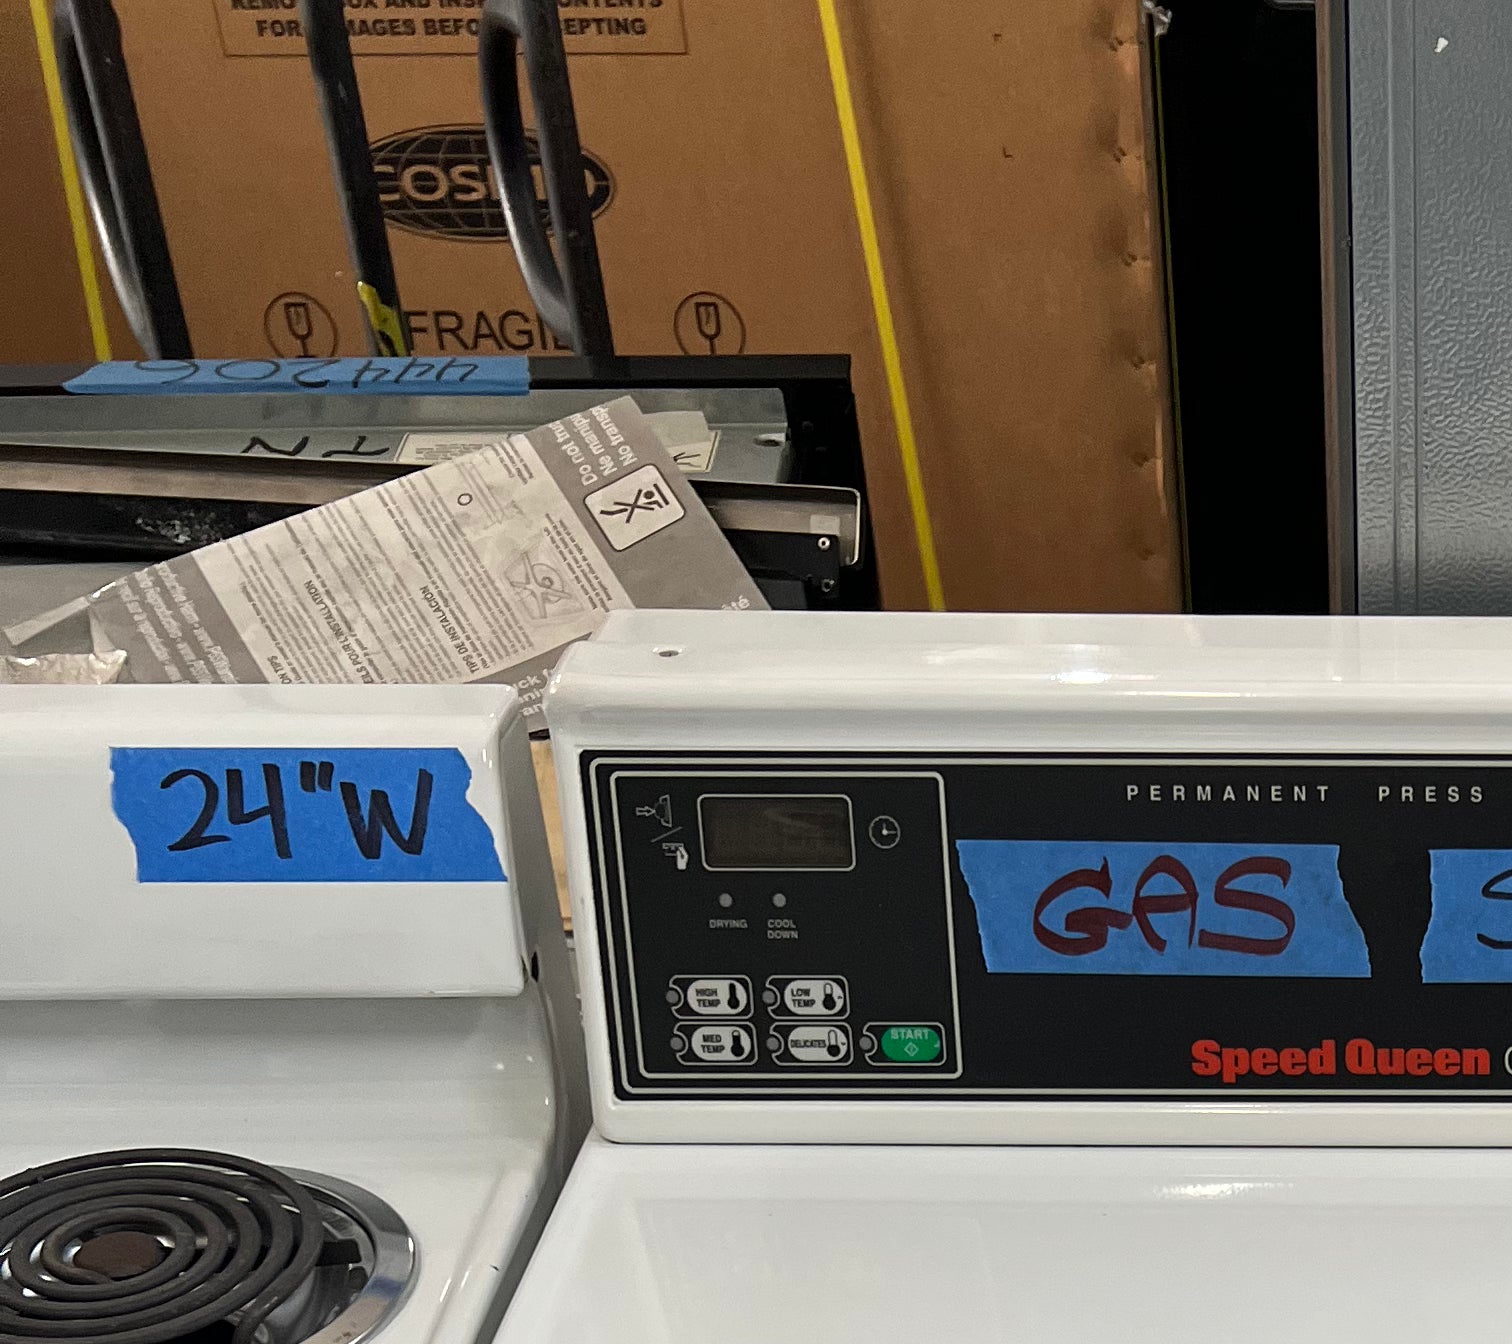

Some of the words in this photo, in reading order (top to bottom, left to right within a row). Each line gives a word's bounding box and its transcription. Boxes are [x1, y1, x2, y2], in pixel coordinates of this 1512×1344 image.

[423, 18, 480, 36] BEFO
[564, 17, 647, 36] EPTING
[1126, 785, 1329, 802] PERMANENT
[1377, 785, 1483, 803] PRESS
[1033, 855, 1296, 957] GAS
[709, 919, 748, 929] DRYING
[767, 919, 797, 929] COOL
[767, 929, 799, 939] DOWN
[790, 988, 811, 997] LOW
[697, 999, 721, 1008] TEMP
[792, 999, 816, 1008] TEMP
[702, 1034, 722, 1043] MED
[890, 1027, 930, 1040] START
[701, 1045, 725, 1053] TEMP
[790, 1039, 826, 1049] DELICATES
[1191, 1039, 1337, 1083] Speed
[1344, 1038, 1491, 1076] Queen
